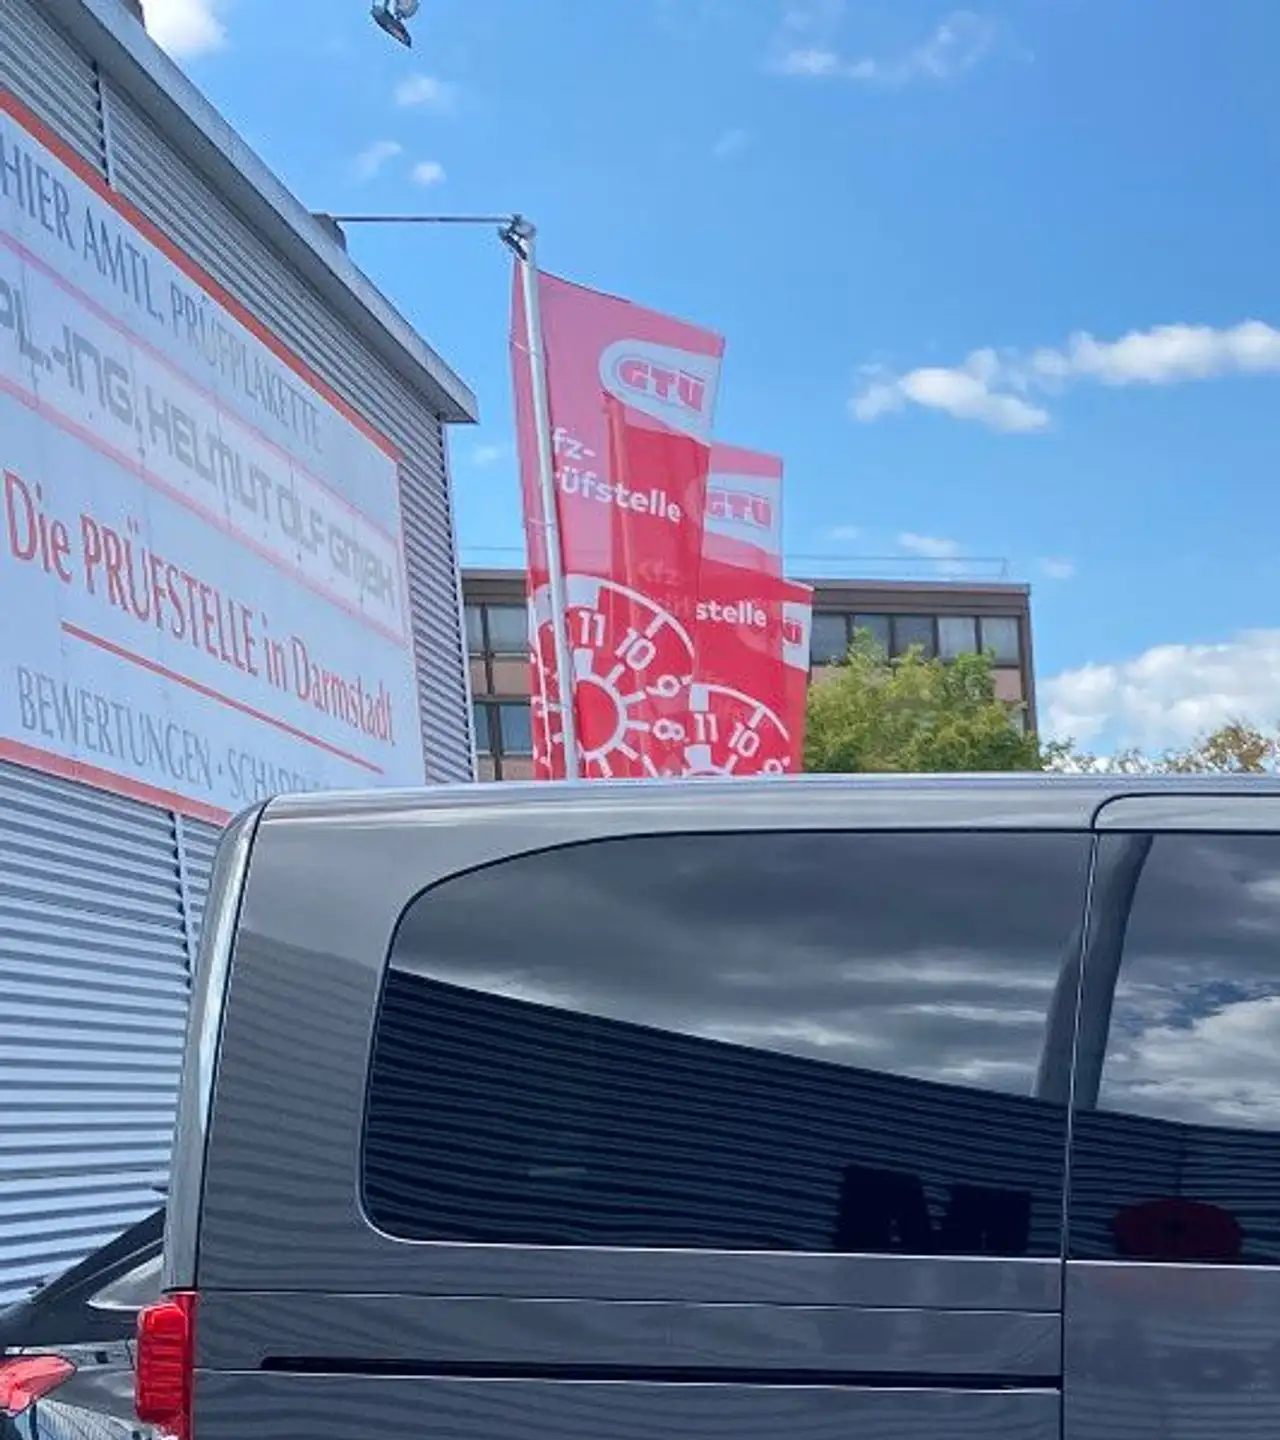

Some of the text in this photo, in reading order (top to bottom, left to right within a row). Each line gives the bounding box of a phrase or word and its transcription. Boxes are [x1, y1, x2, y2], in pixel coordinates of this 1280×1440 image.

[0, 130, 76, 251] HIER
[82, 206, 165, 326] AMTL.
[616, 358, 706, 414] GTÜ
[552, 427, 597, 461] fz-
[555, 464, 684, 523] üfstelle
[3, 467, 73, 584] Die
[79, 512, 259, 677] PRÜFSTELLE
[261, 611, 287, 692] in
[291, 634, 396, 747] Darmstadt
[579, 609, 606, 647] 11
[614, 626, 657, 671] 10
[17, 666, 213, 791] BEWERTUNGEN
[693, 711, 719, 743] 11
[728, 721, 760, 758] 10
